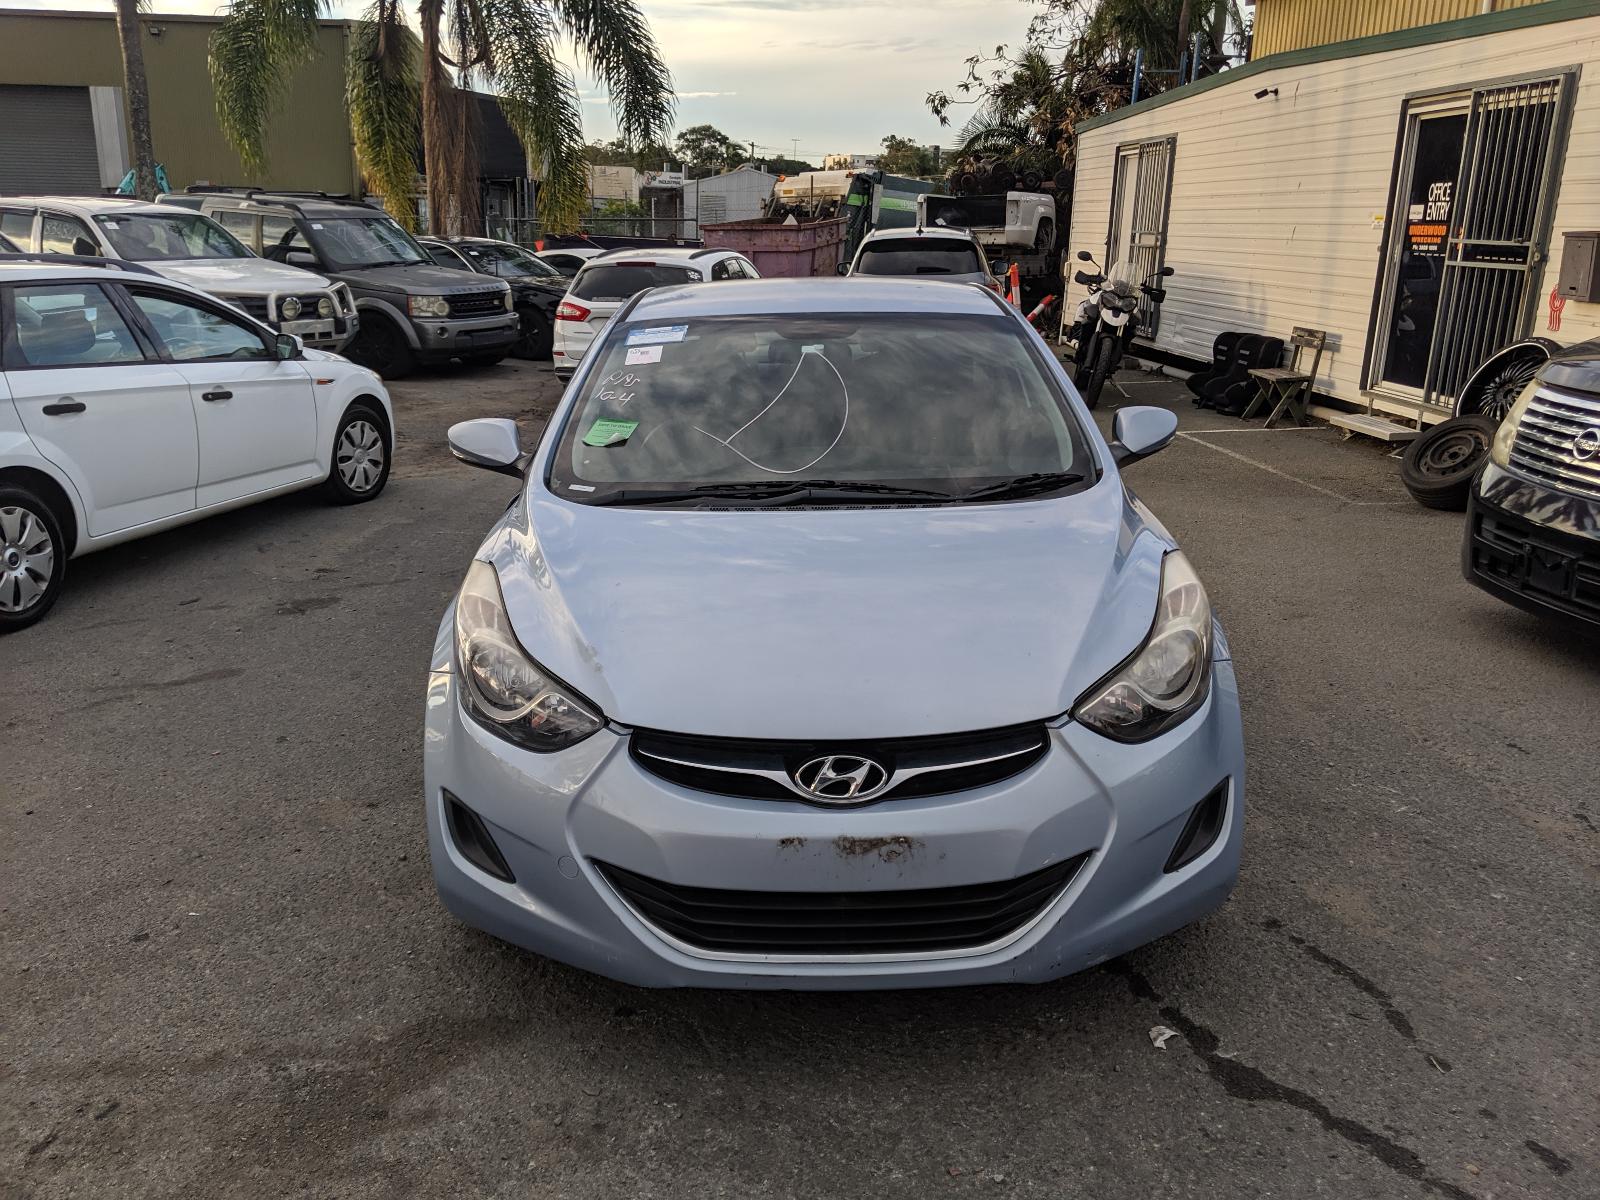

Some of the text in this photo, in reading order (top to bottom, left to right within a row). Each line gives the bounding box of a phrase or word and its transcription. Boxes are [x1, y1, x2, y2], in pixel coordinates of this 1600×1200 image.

[1429, 182, 1452, 201] OFFICE
[1426, 201, 1450, 221] ENTRY
[1409, 225, 1447, 236] UNDERWOOD
[1411, 236, 1441, 244] WRECKING
